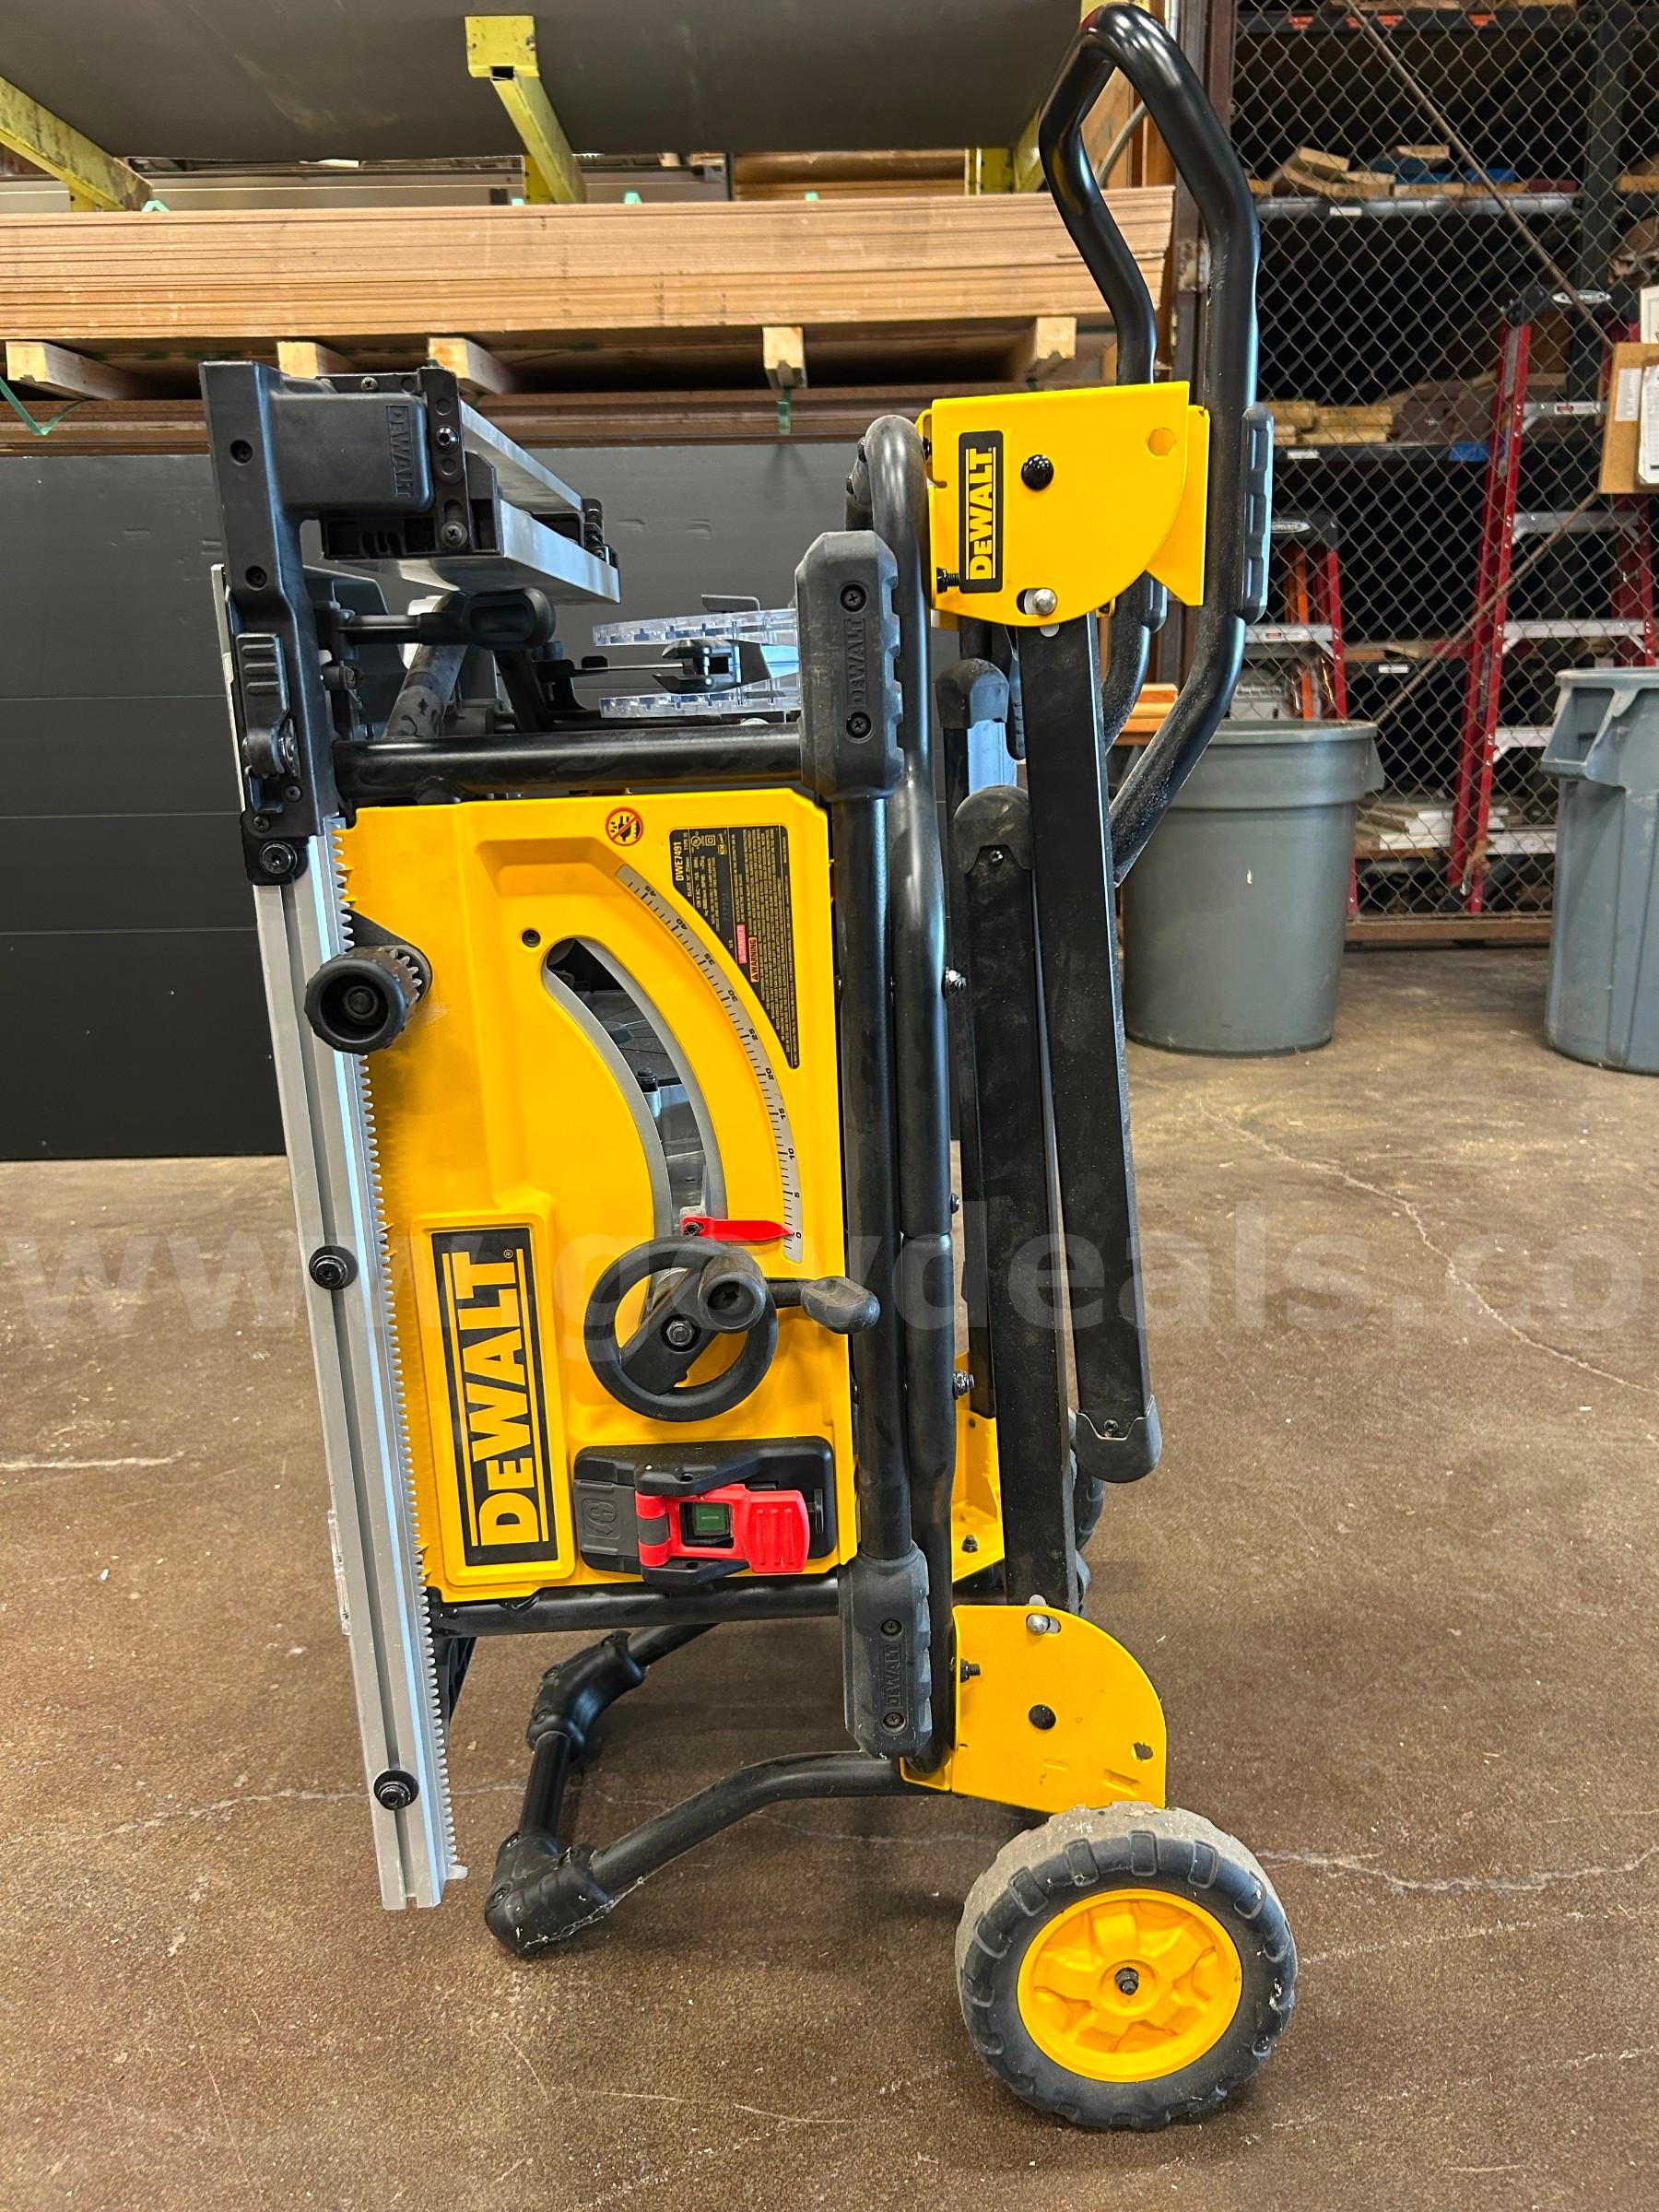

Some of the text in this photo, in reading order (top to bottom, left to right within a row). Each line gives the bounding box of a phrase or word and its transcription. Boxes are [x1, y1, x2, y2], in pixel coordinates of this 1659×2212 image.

[970, 448, 993, 580] DEWALT
[847, 619, 865, 704] DEWALT
[674, 841, 684, 881] DWE7491
[645, 886, 656, 897] 45
[676, 918, 688, 930] 40
[704, 953, 715, 966] 35
[749, 939, 758, 973] WARNING
[728, 990, 738, 1002] 30
[748, 1028, 758, 1041] 25
[766, 1067, 774, 1080] 20
[779, 1108, 786, 1120] 15
[788, 1148, 795, 1159] 10
[452, 1251, 540, 1546] DEWALT
